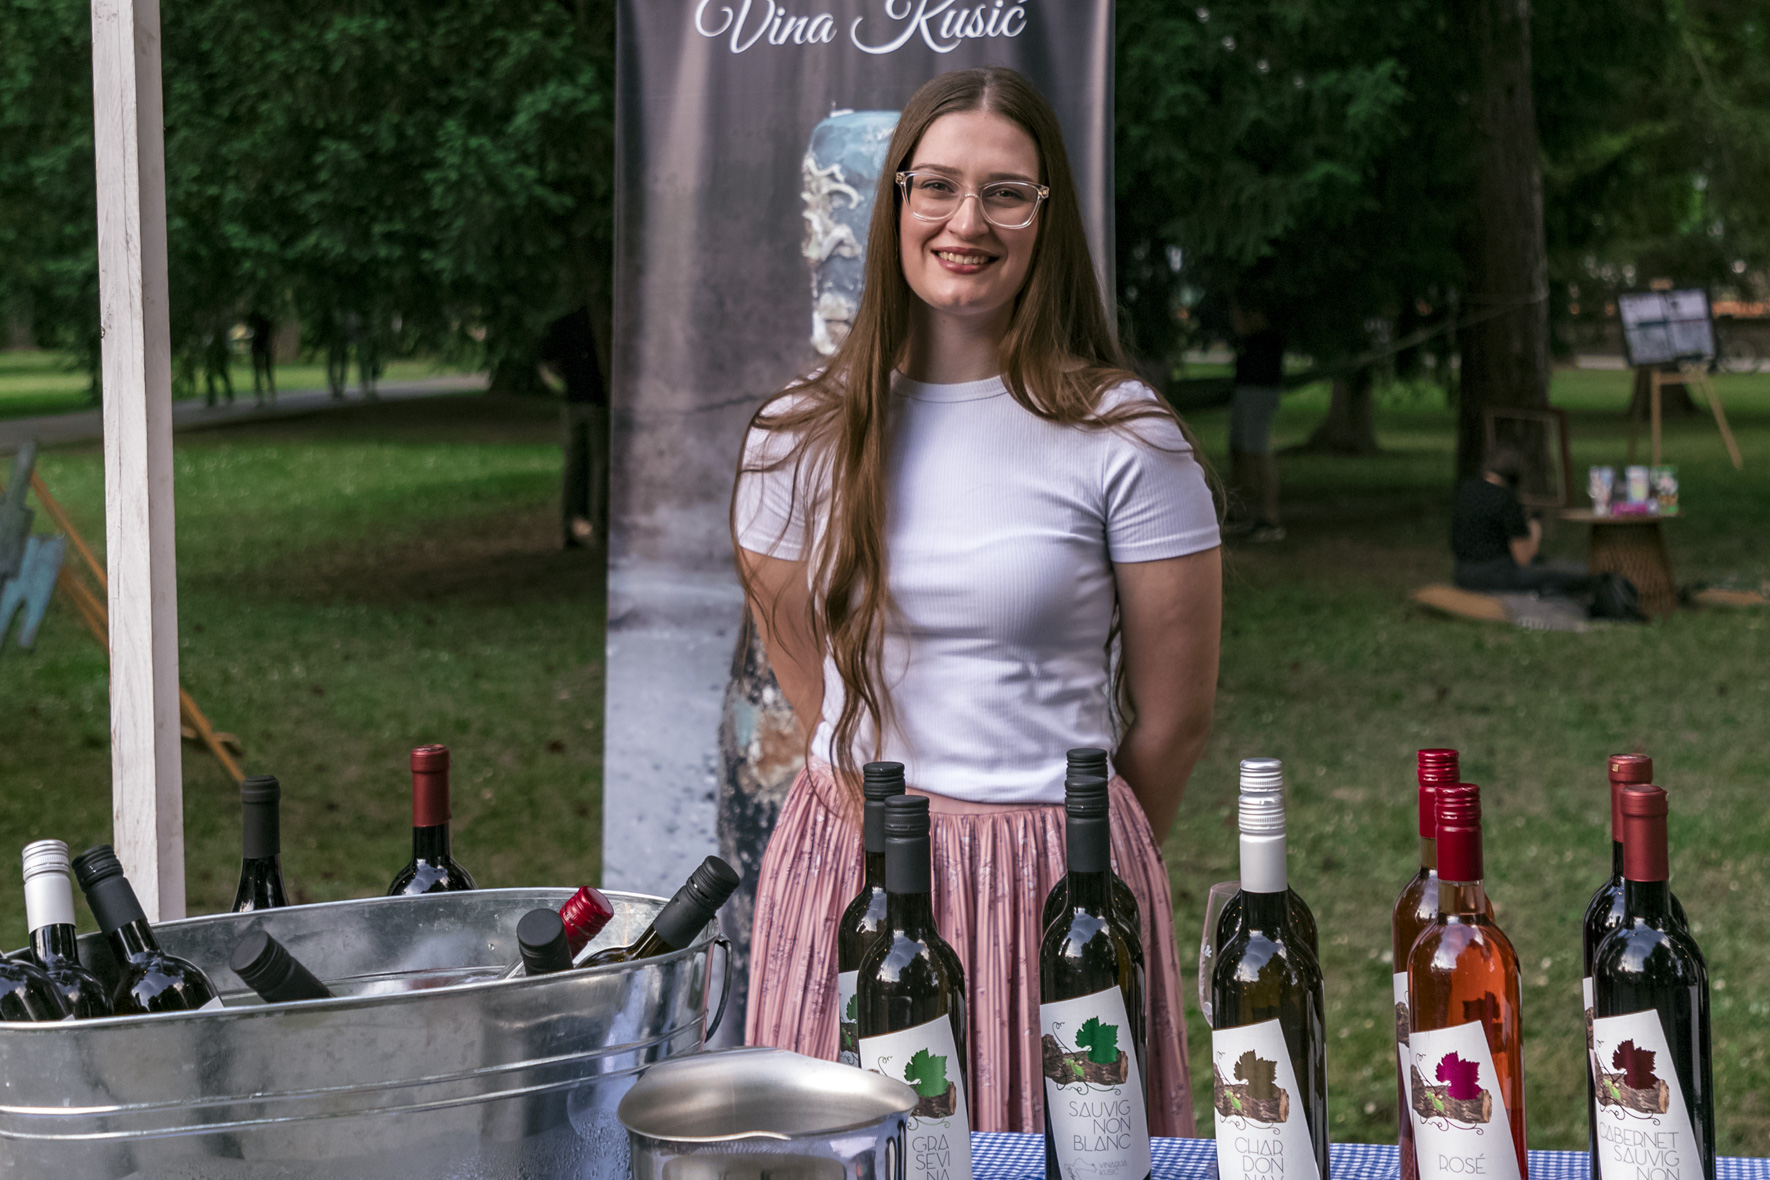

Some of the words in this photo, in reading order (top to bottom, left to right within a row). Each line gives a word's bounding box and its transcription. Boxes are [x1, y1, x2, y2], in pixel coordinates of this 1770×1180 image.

[695, 0, 837, 53] Vina
[1069, 1099, 1131, 1118] SAUVIG
[1093, 1115, 1131, 1134] NON
[912, 1133, 949, 1153] GRA
[1073, 1133, 1131, 1152] BLANC
[1599, 1121, 1680, 1149] CABERNET
[1234, 1136, 1284, 1157] CHAR
[1614, 1144, 1680, 1167] SAUVIG
[915, 1150, 951, 1171] SEVI
[1242, 1154, 1284, 1174] DON
[1439, 1152, 1486, 1175] ROSÉ
[1636, 1166, 1680, 1180] NON
